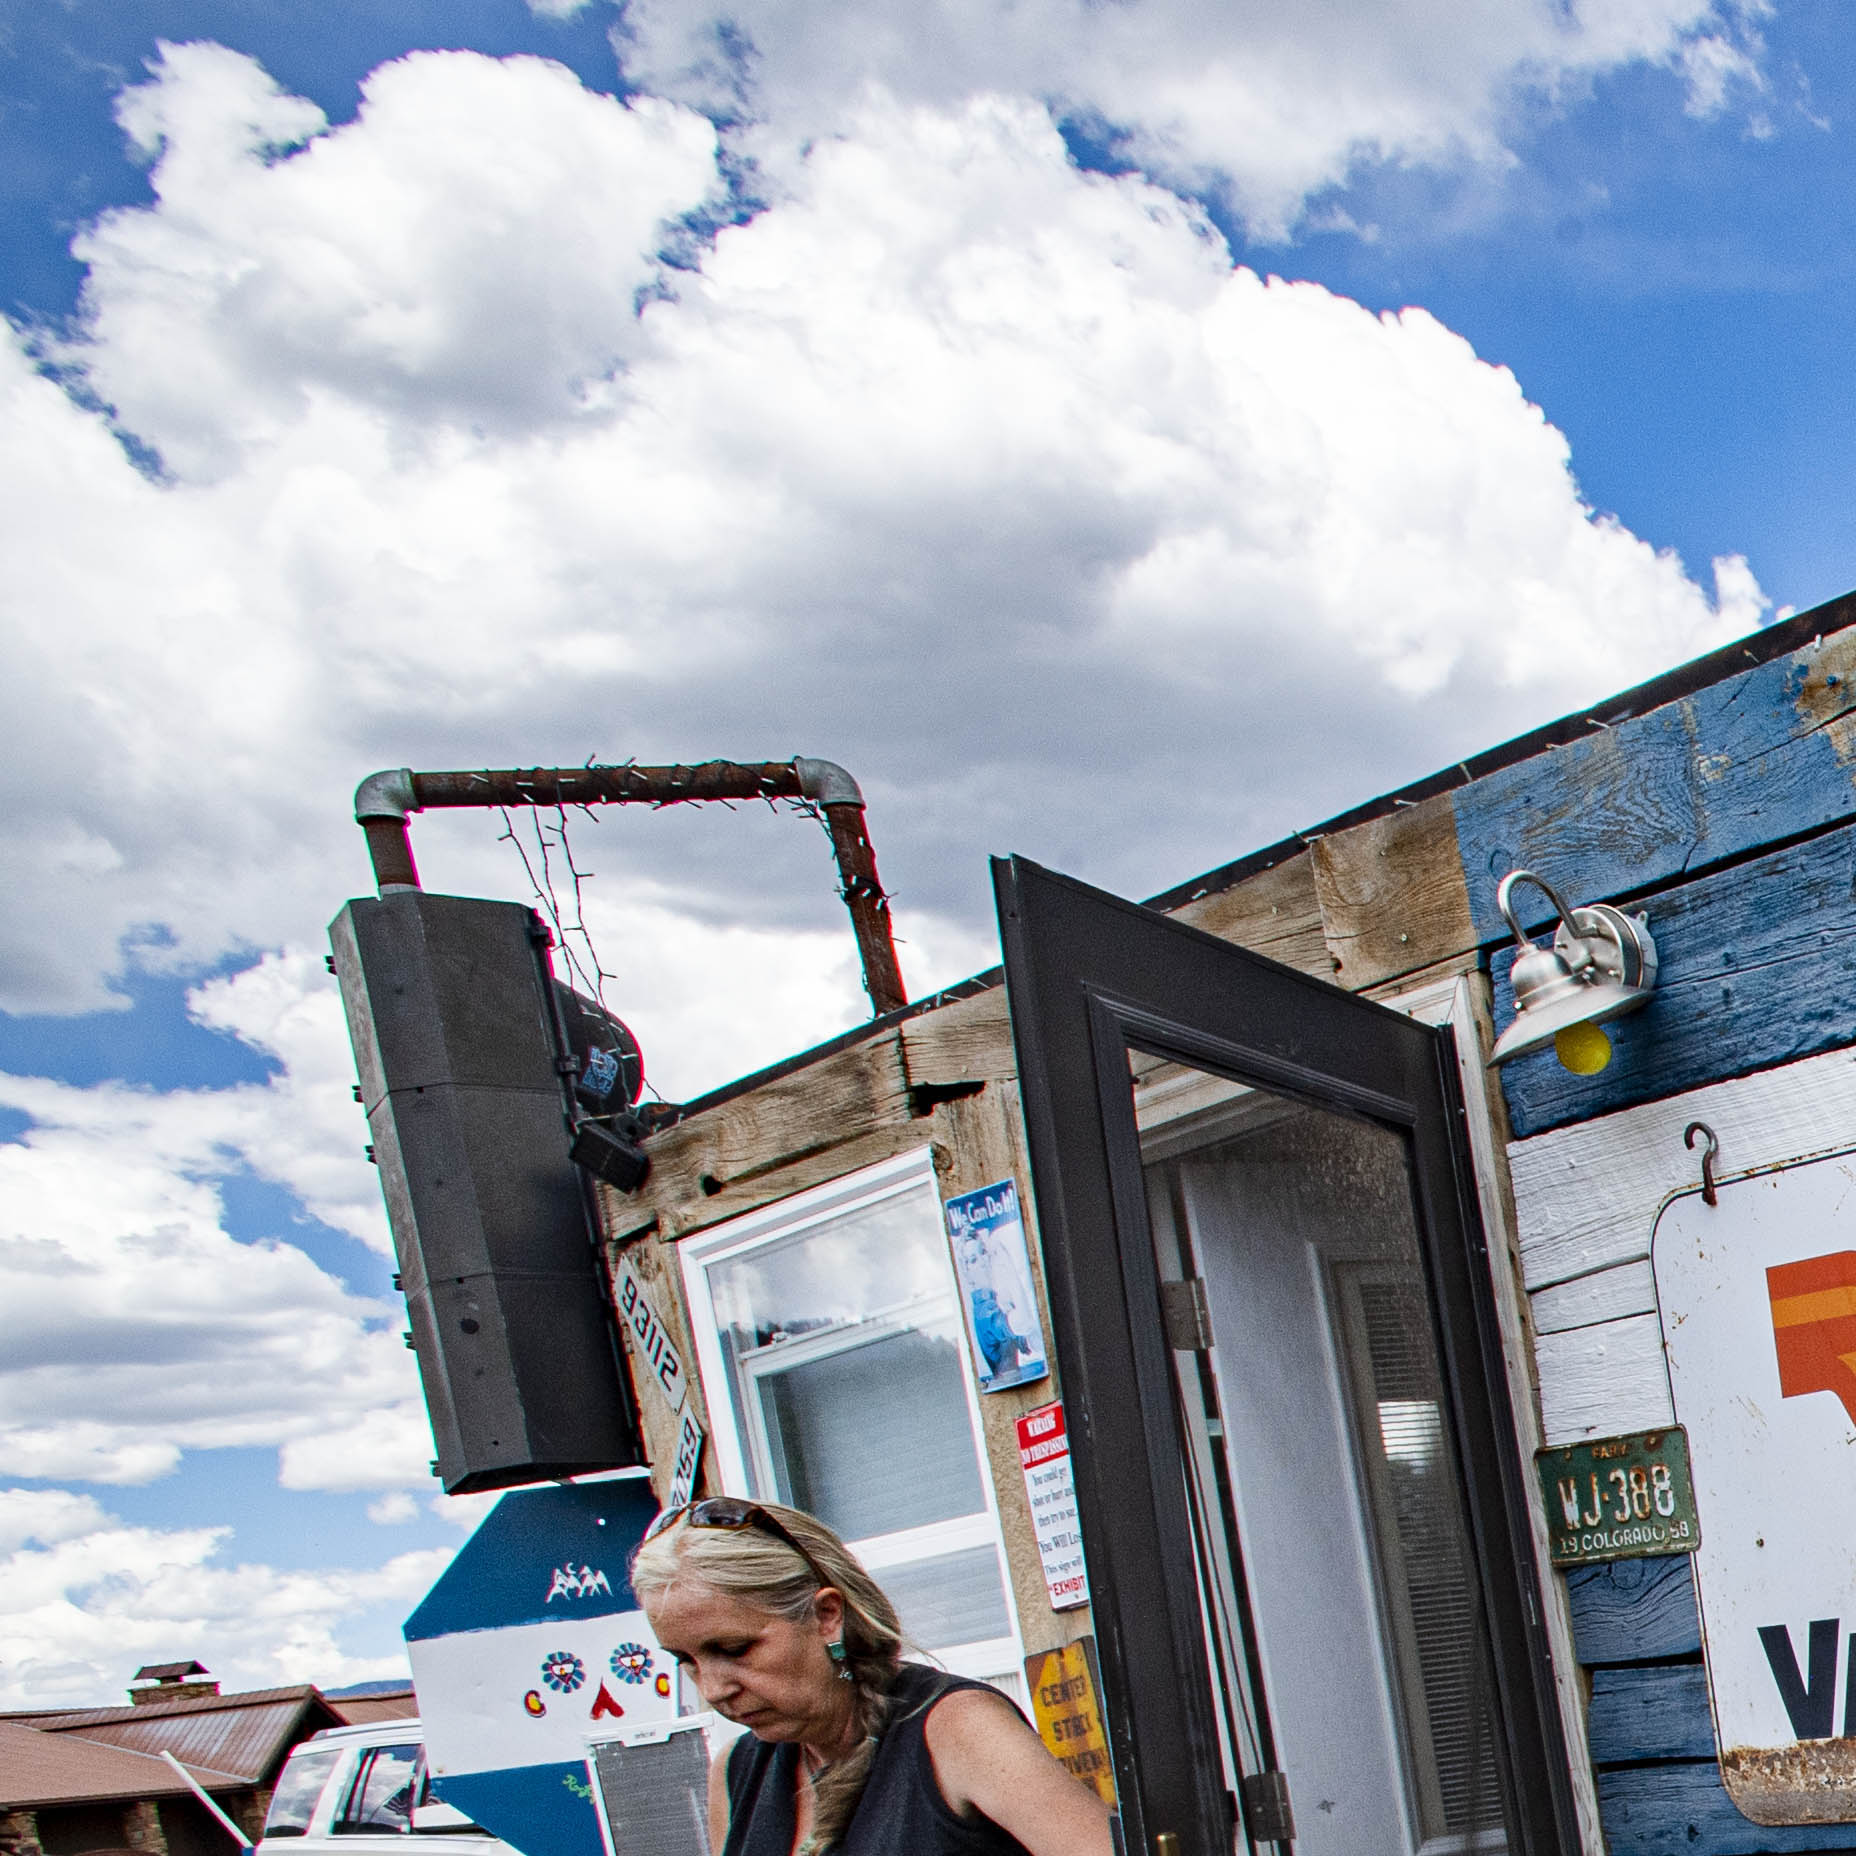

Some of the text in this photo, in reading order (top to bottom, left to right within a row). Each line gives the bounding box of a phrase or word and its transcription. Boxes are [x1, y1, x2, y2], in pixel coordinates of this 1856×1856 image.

[949, 1207, 968, 1230] We
[967, 1201, 987, 1222] Can
[1581, 1523, 1666, 1551] COLORADO
